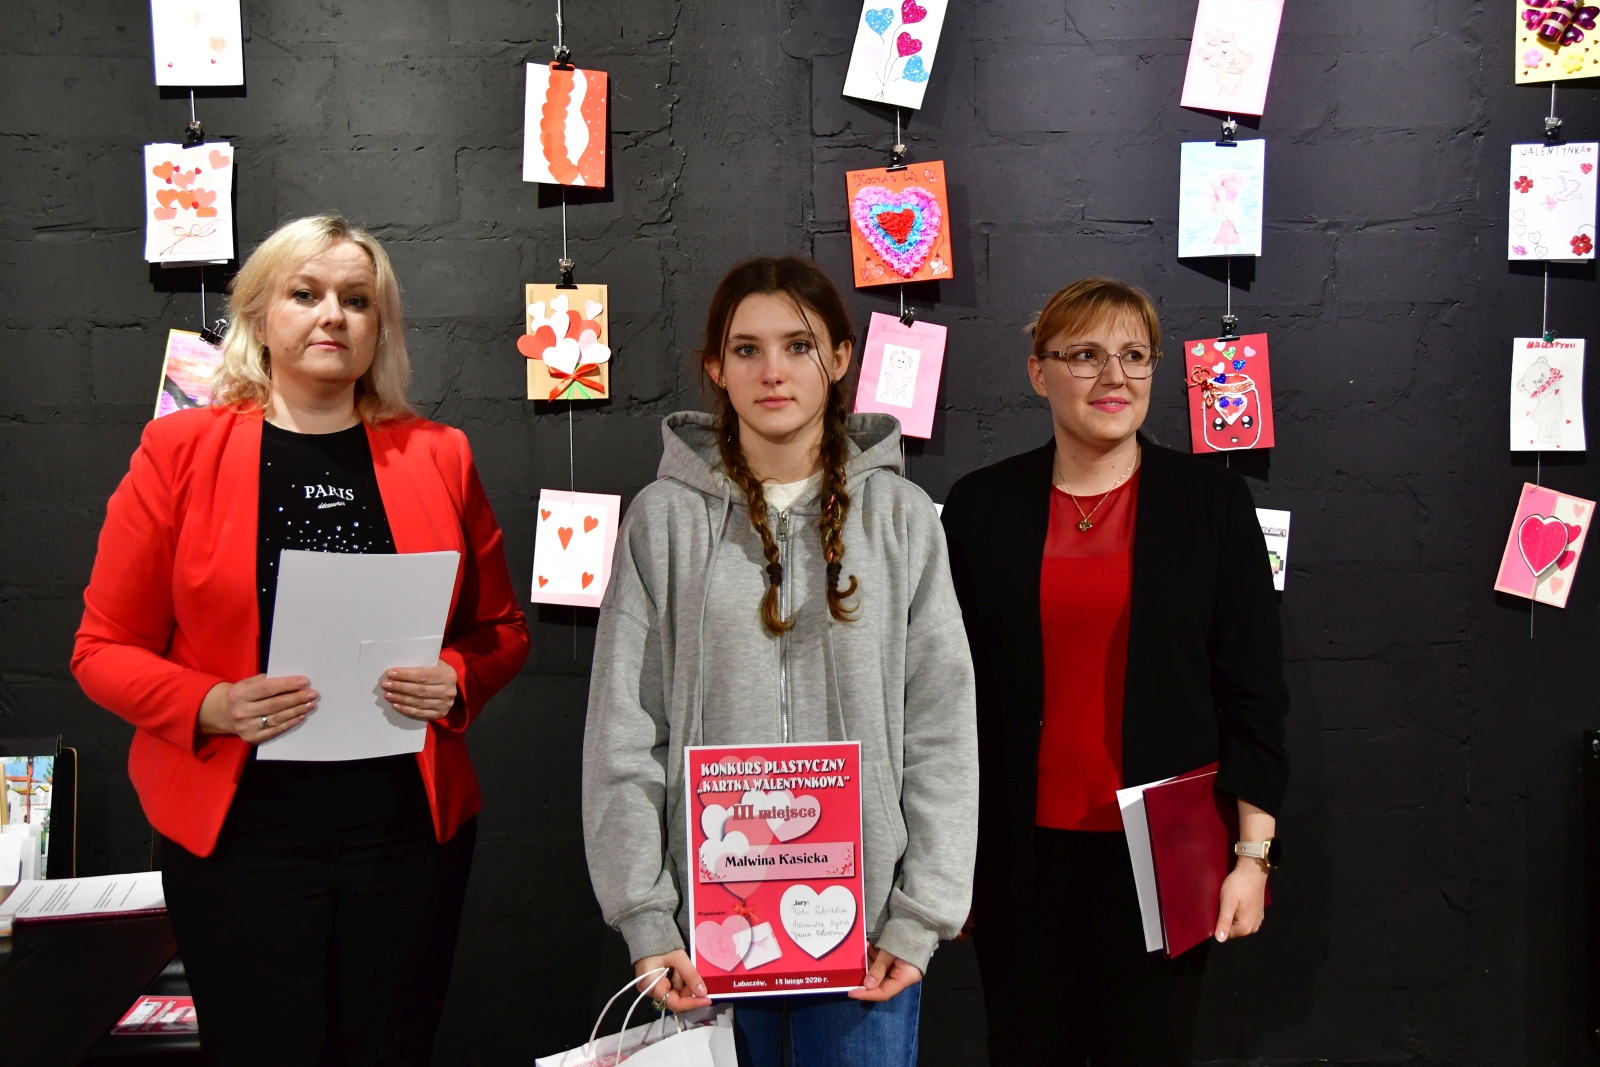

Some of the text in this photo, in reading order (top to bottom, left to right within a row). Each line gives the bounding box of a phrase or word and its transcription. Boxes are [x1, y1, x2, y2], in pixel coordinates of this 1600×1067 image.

[1520, 146, 1586, 156] WALENTYNKA
[303, 484, 355, 501] PARIS
[701, 758, 846, 777] KONKURS PLASTYCZNY
[697, 776, 850, 794] „KARTKA WALENTYNKOWA”
[732, 804, 816, 821] III miejsce
[725, 852, 829, 867] Malwina Kasicka
[793, 899, 810, 907] Jury:
[775, 978, 783, 986] 14
[784, 977, 804, 986] lutego
